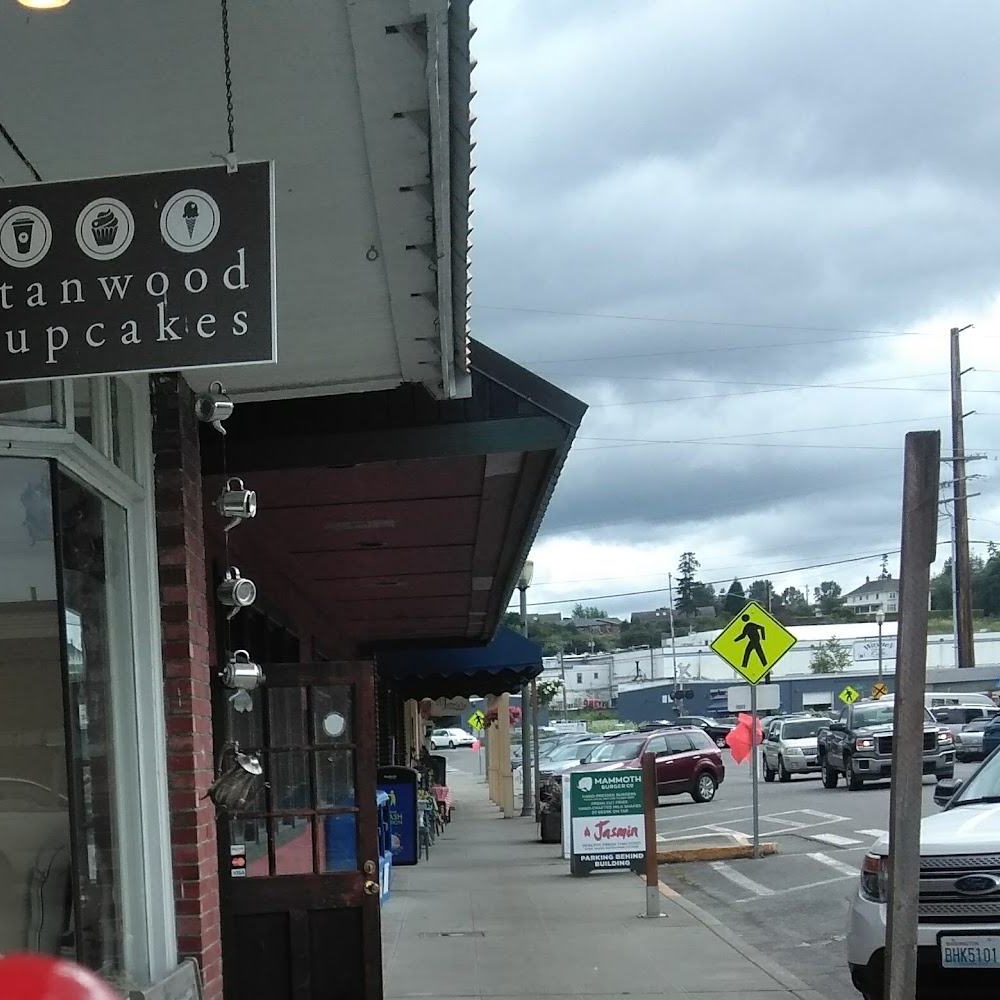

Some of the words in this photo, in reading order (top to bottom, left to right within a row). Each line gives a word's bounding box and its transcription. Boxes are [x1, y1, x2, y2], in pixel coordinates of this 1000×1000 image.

[594, 775, 642, 784] MAMMOTH
[594, 820, 638, 841] Jasmin
[944, 947, 997, 963] BHK5101
